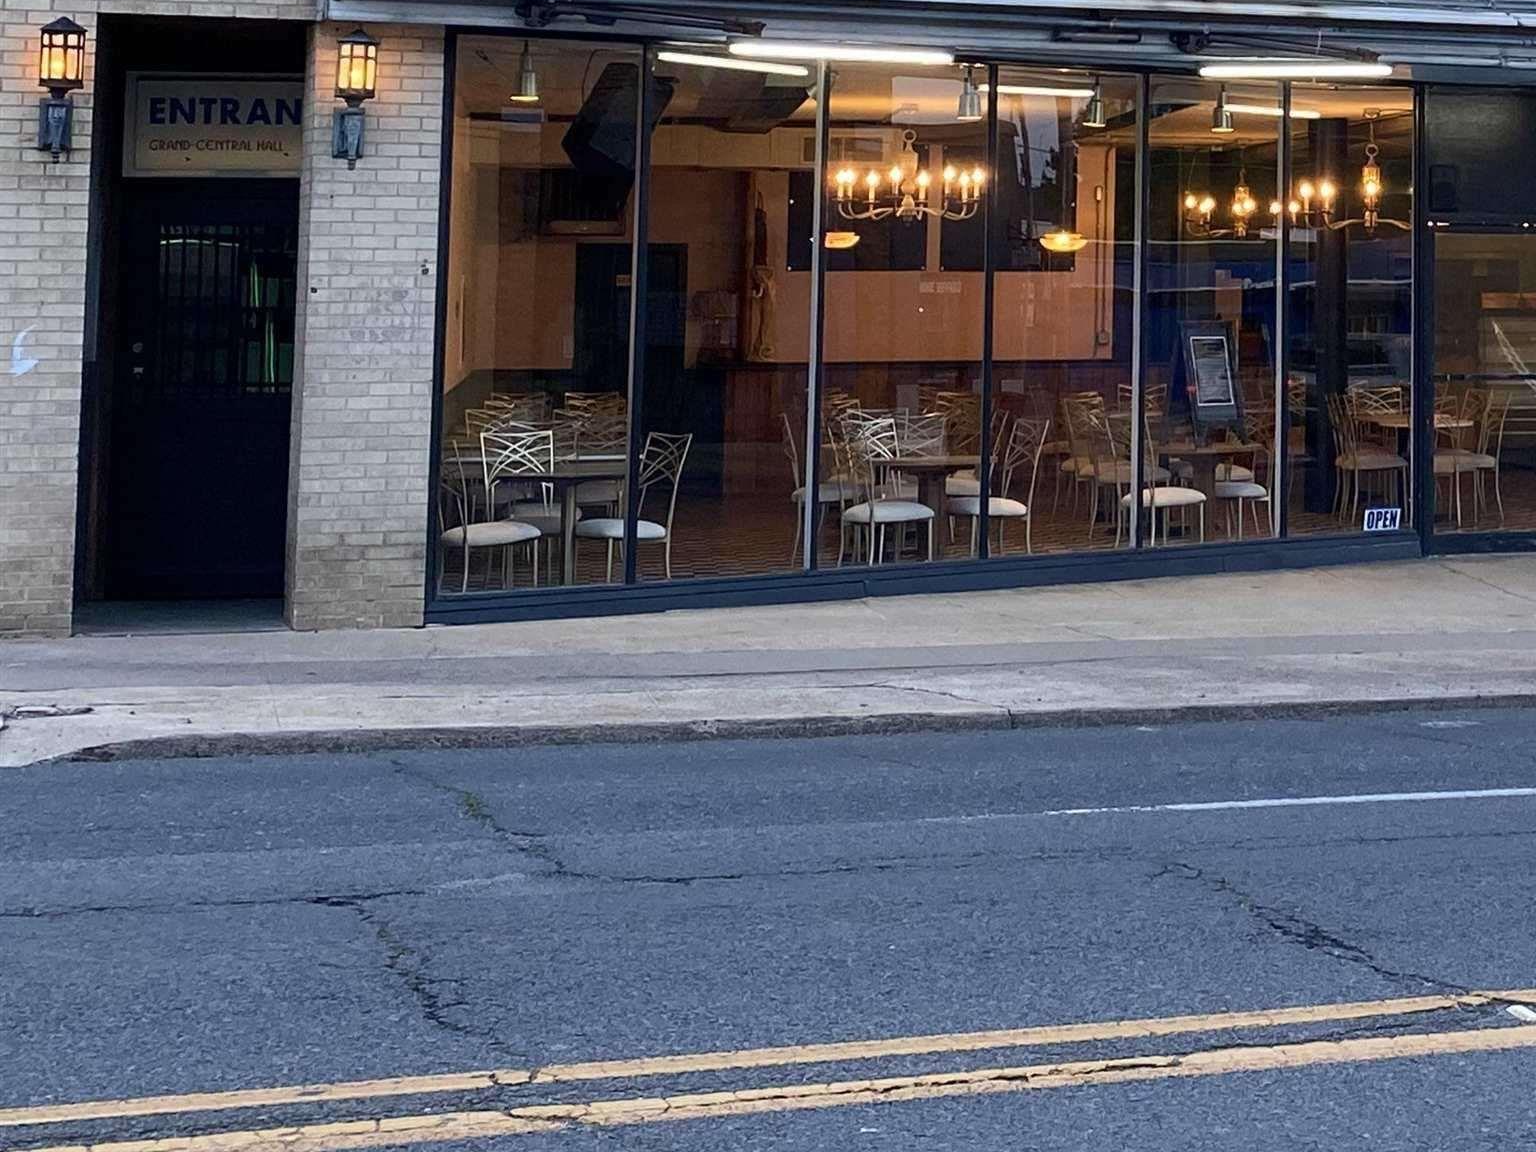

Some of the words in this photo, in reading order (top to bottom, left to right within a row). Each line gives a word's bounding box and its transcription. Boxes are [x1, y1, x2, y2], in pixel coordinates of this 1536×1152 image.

[196, 139, 251, 151] CENTRAL
[256, 140, 284, 152] HALL
[1367, 510, 1398, 529] OPEN
